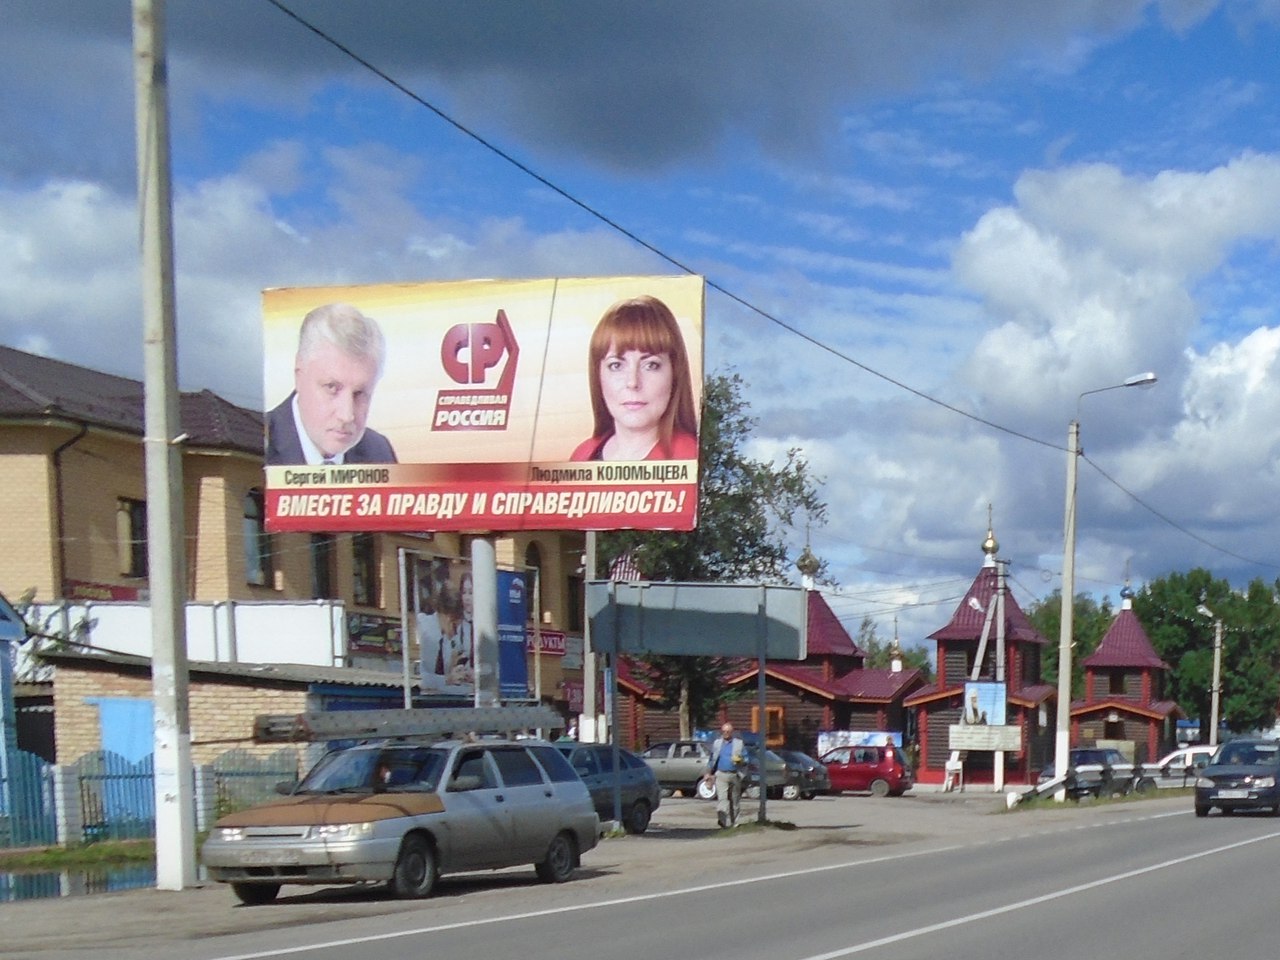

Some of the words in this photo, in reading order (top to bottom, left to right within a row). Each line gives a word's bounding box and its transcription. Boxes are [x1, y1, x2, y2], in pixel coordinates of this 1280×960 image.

[435, 410, 507, 427] РОССИЯ
[284, 469, 327, 486] Сергей
[330, 468, 390, 484] МИРОНОВ
[531, 466, 593, 484] Людмила
[596, 464, 689, 483] КОЛОМЫЦЕВА
[276, 494, 354, 517] ВМЕСТЕ
[356, 493, 382, 516] ЗА
[386, 493, 469, 519] ПРАВДУ
[471, 492, 488, 515] И
[491, 489, 687, 518] СПРАВЕДЛИВОСТЬ!
